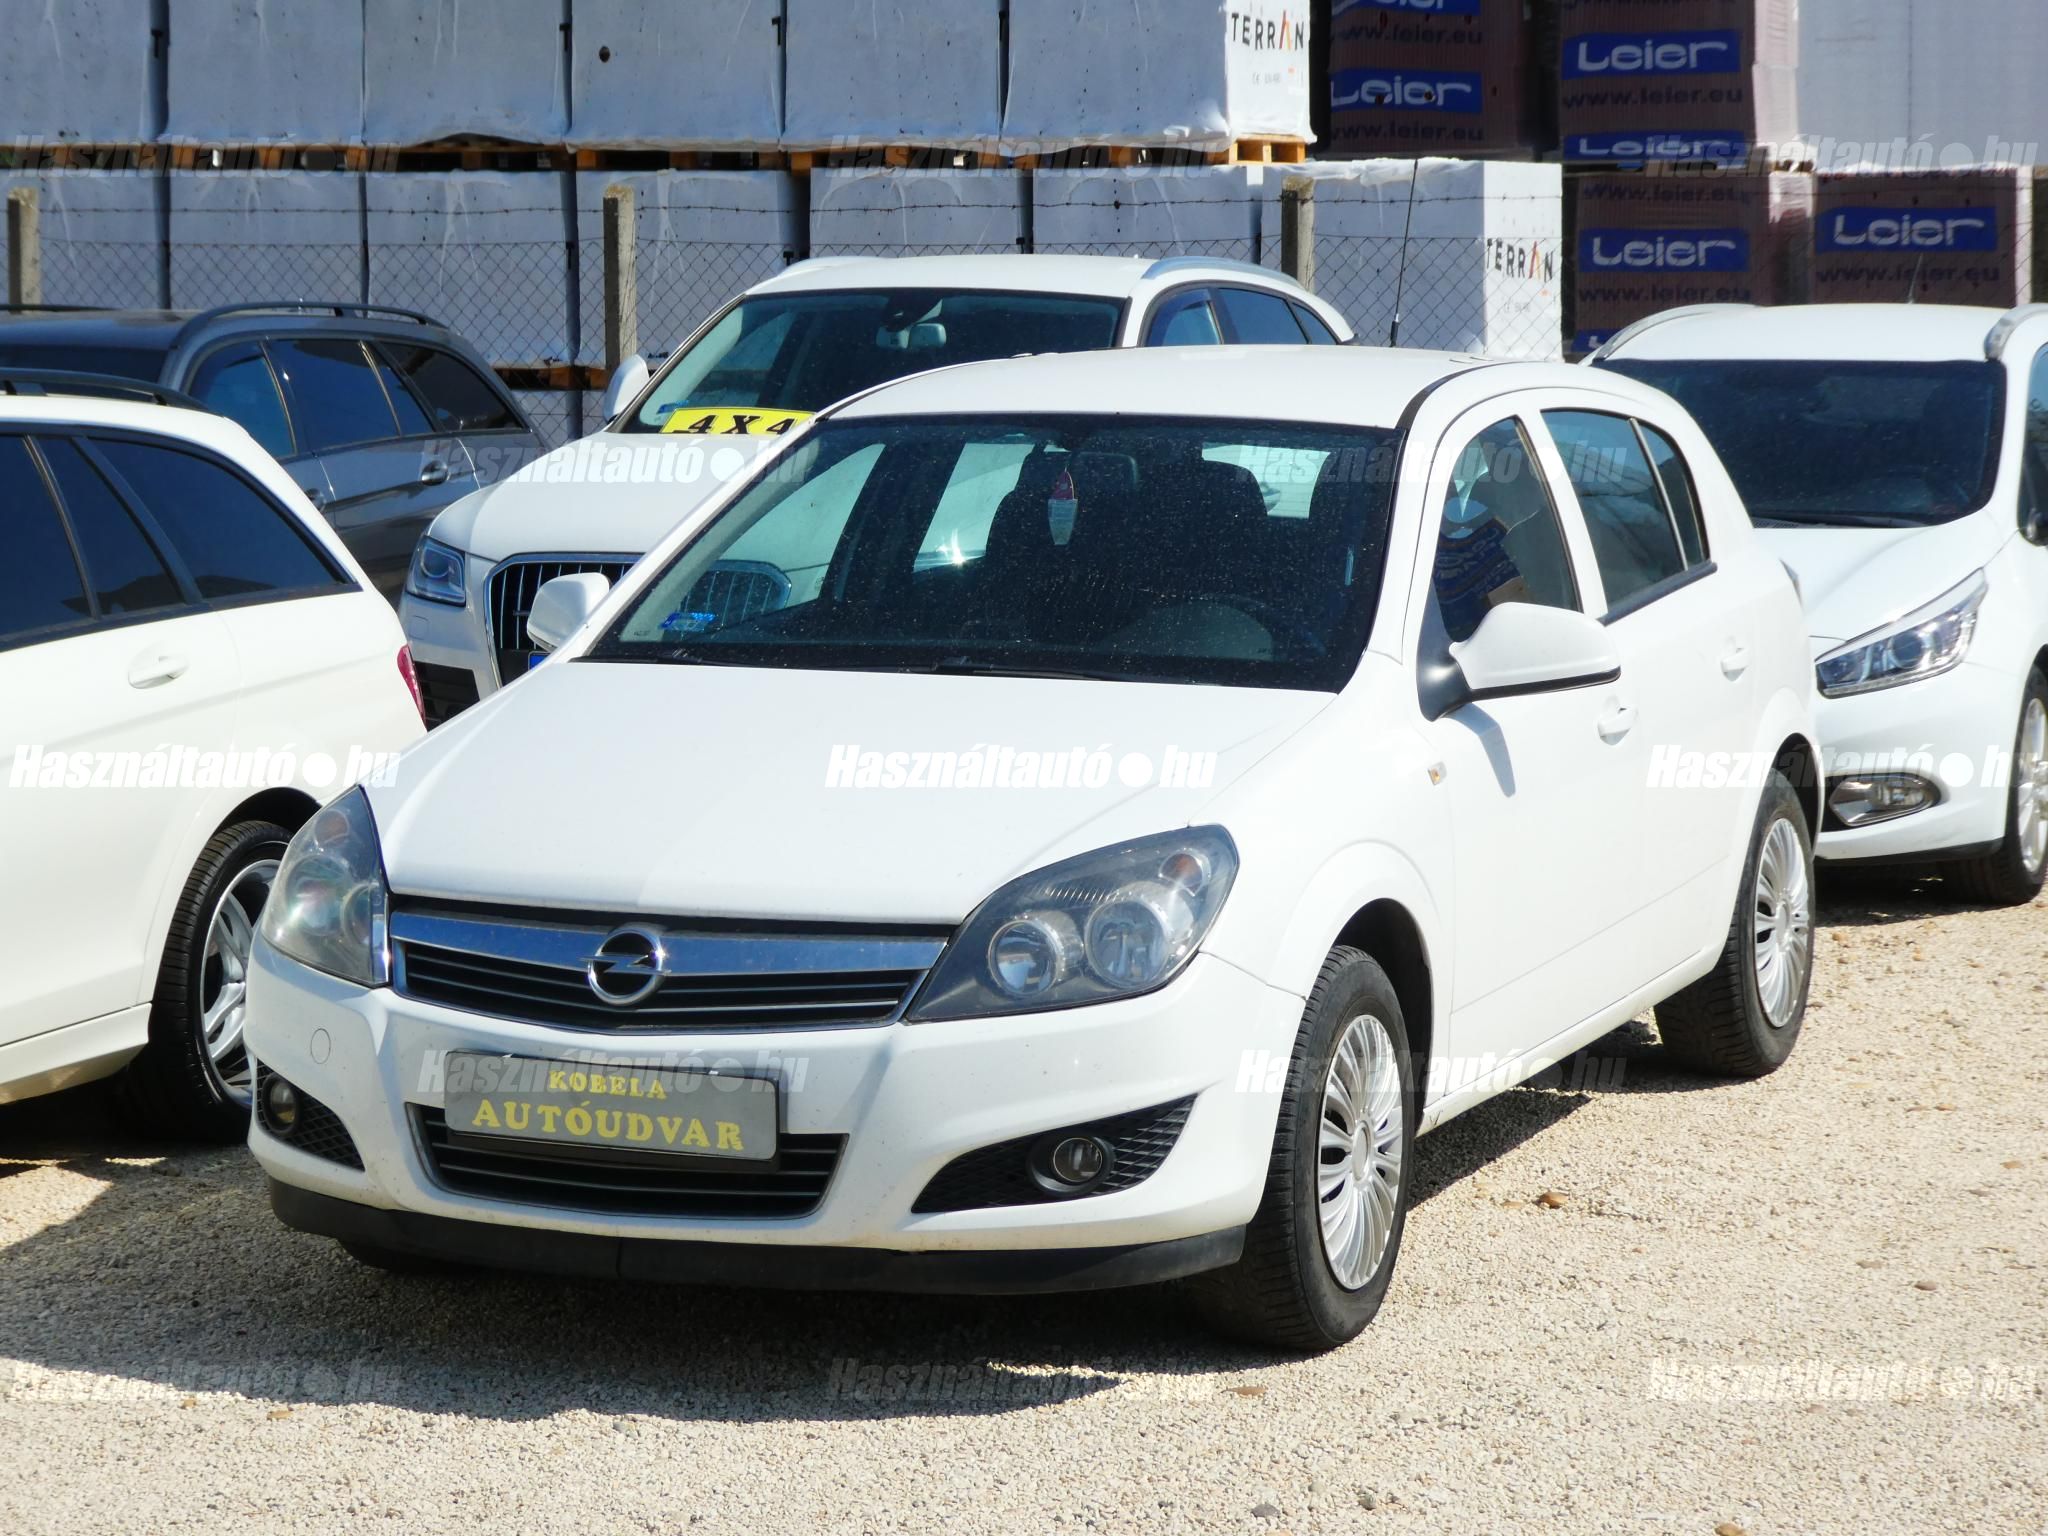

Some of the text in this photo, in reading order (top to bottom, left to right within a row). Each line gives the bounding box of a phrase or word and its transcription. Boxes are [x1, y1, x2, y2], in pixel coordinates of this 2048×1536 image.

[1577, 39, 1729, 72] Leier
[1331, 75, 1473, 107] Leier
[1563, 85, 1744, 110] www.leier.eu
[1834, 213, 1985, 247] Leier
[1592, 236, 1737, 268] Leier
[549, 1070, 667, 1100] KOBELA
[471, 1099, 745, 1150] AUTÓUDVAR
